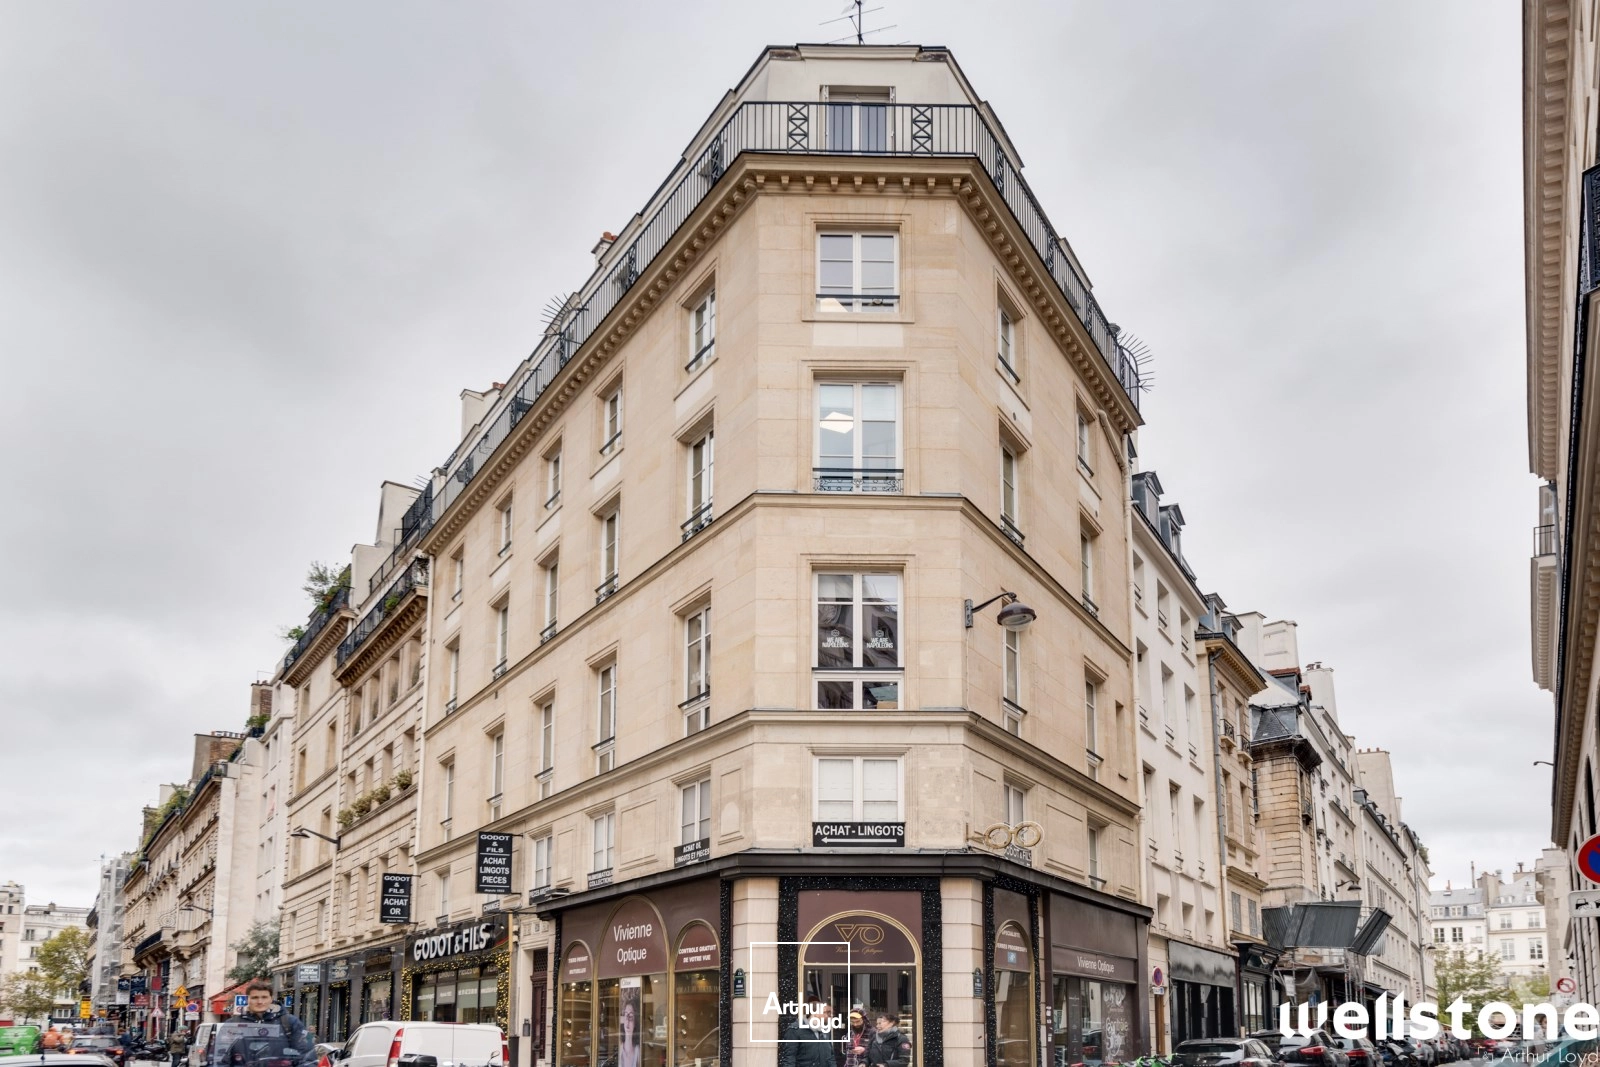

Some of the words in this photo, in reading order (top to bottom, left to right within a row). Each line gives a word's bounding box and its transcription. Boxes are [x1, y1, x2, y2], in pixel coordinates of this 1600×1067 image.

[815, 825, 851, 835] ACHAT
[858, 825, 904, 836] LINGOTS
[483, 857, 506, 865] ACHAT
[480, 866, 510, 875] LINGOTS
[482, 875, 507, 884] PIECES
[383, 898, 409, 906] ACHAT
[390, 907, 401, 915] OR
[613, 923, 652, 942] Vivienne
[414, 931, 454, 961] GODOT
[454, 934, 461, 954] &
[462, 923, 491, 953] FILS
[616, 947, 647, 965] Optique
[1077, 955, 1097, 970] Vivienne
[1097, 959, 1115, 974] Optique
